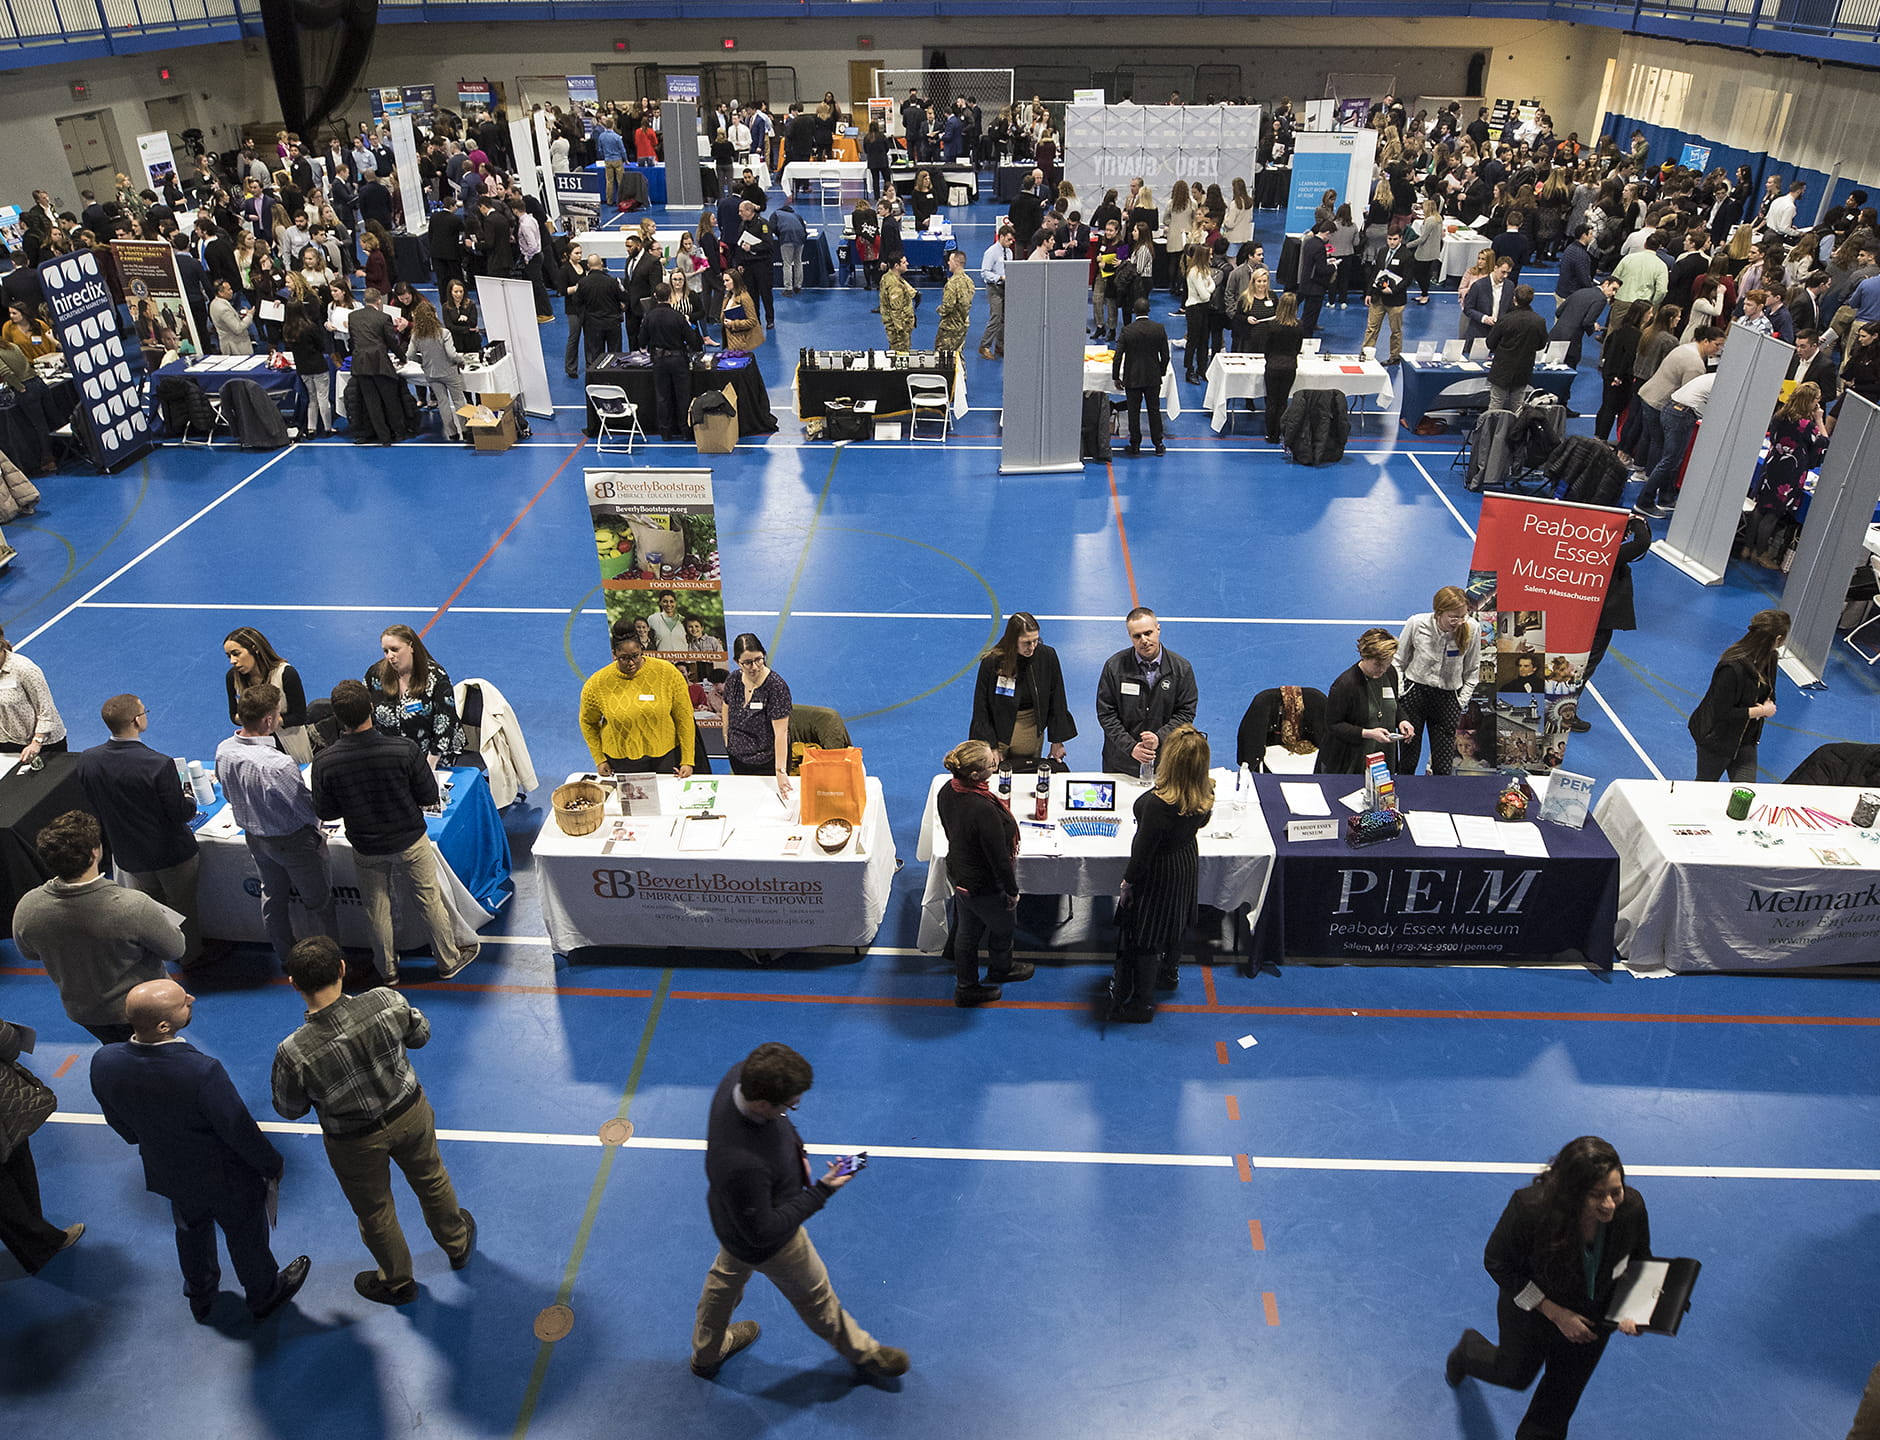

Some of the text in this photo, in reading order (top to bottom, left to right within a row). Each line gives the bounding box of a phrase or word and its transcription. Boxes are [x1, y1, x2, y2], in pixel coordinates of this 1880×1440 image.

[558, 177, 583, 190] HSI
[52, 280, 106, 315] hireclix
[616, 481, 706, 494] BeverlyBootstraps
[615, 505, 688, 514] BeverlyBootstraps.org
[1523, 513, 1618, 549] Peabody
[1554, 541, 1612, 566] Essex
[1512, 557, 1604, 588] Museum
[1523, 585, 1600, 602] Salem, Massachusetts
[1560, 777, 1595, 793] PEM
[637, 870, 823, 895] BeverlyBootstraps
[639, 891, 824, 905] EMBRACE EDUCATE EMPOWER
[1744, 883, 1880, 913] Melmark
[1329, 921, 1520, 937] Peabody Essex Museum
[1343, 941, 1504, 953] Salem, MA 978-745-9500 pem.org
